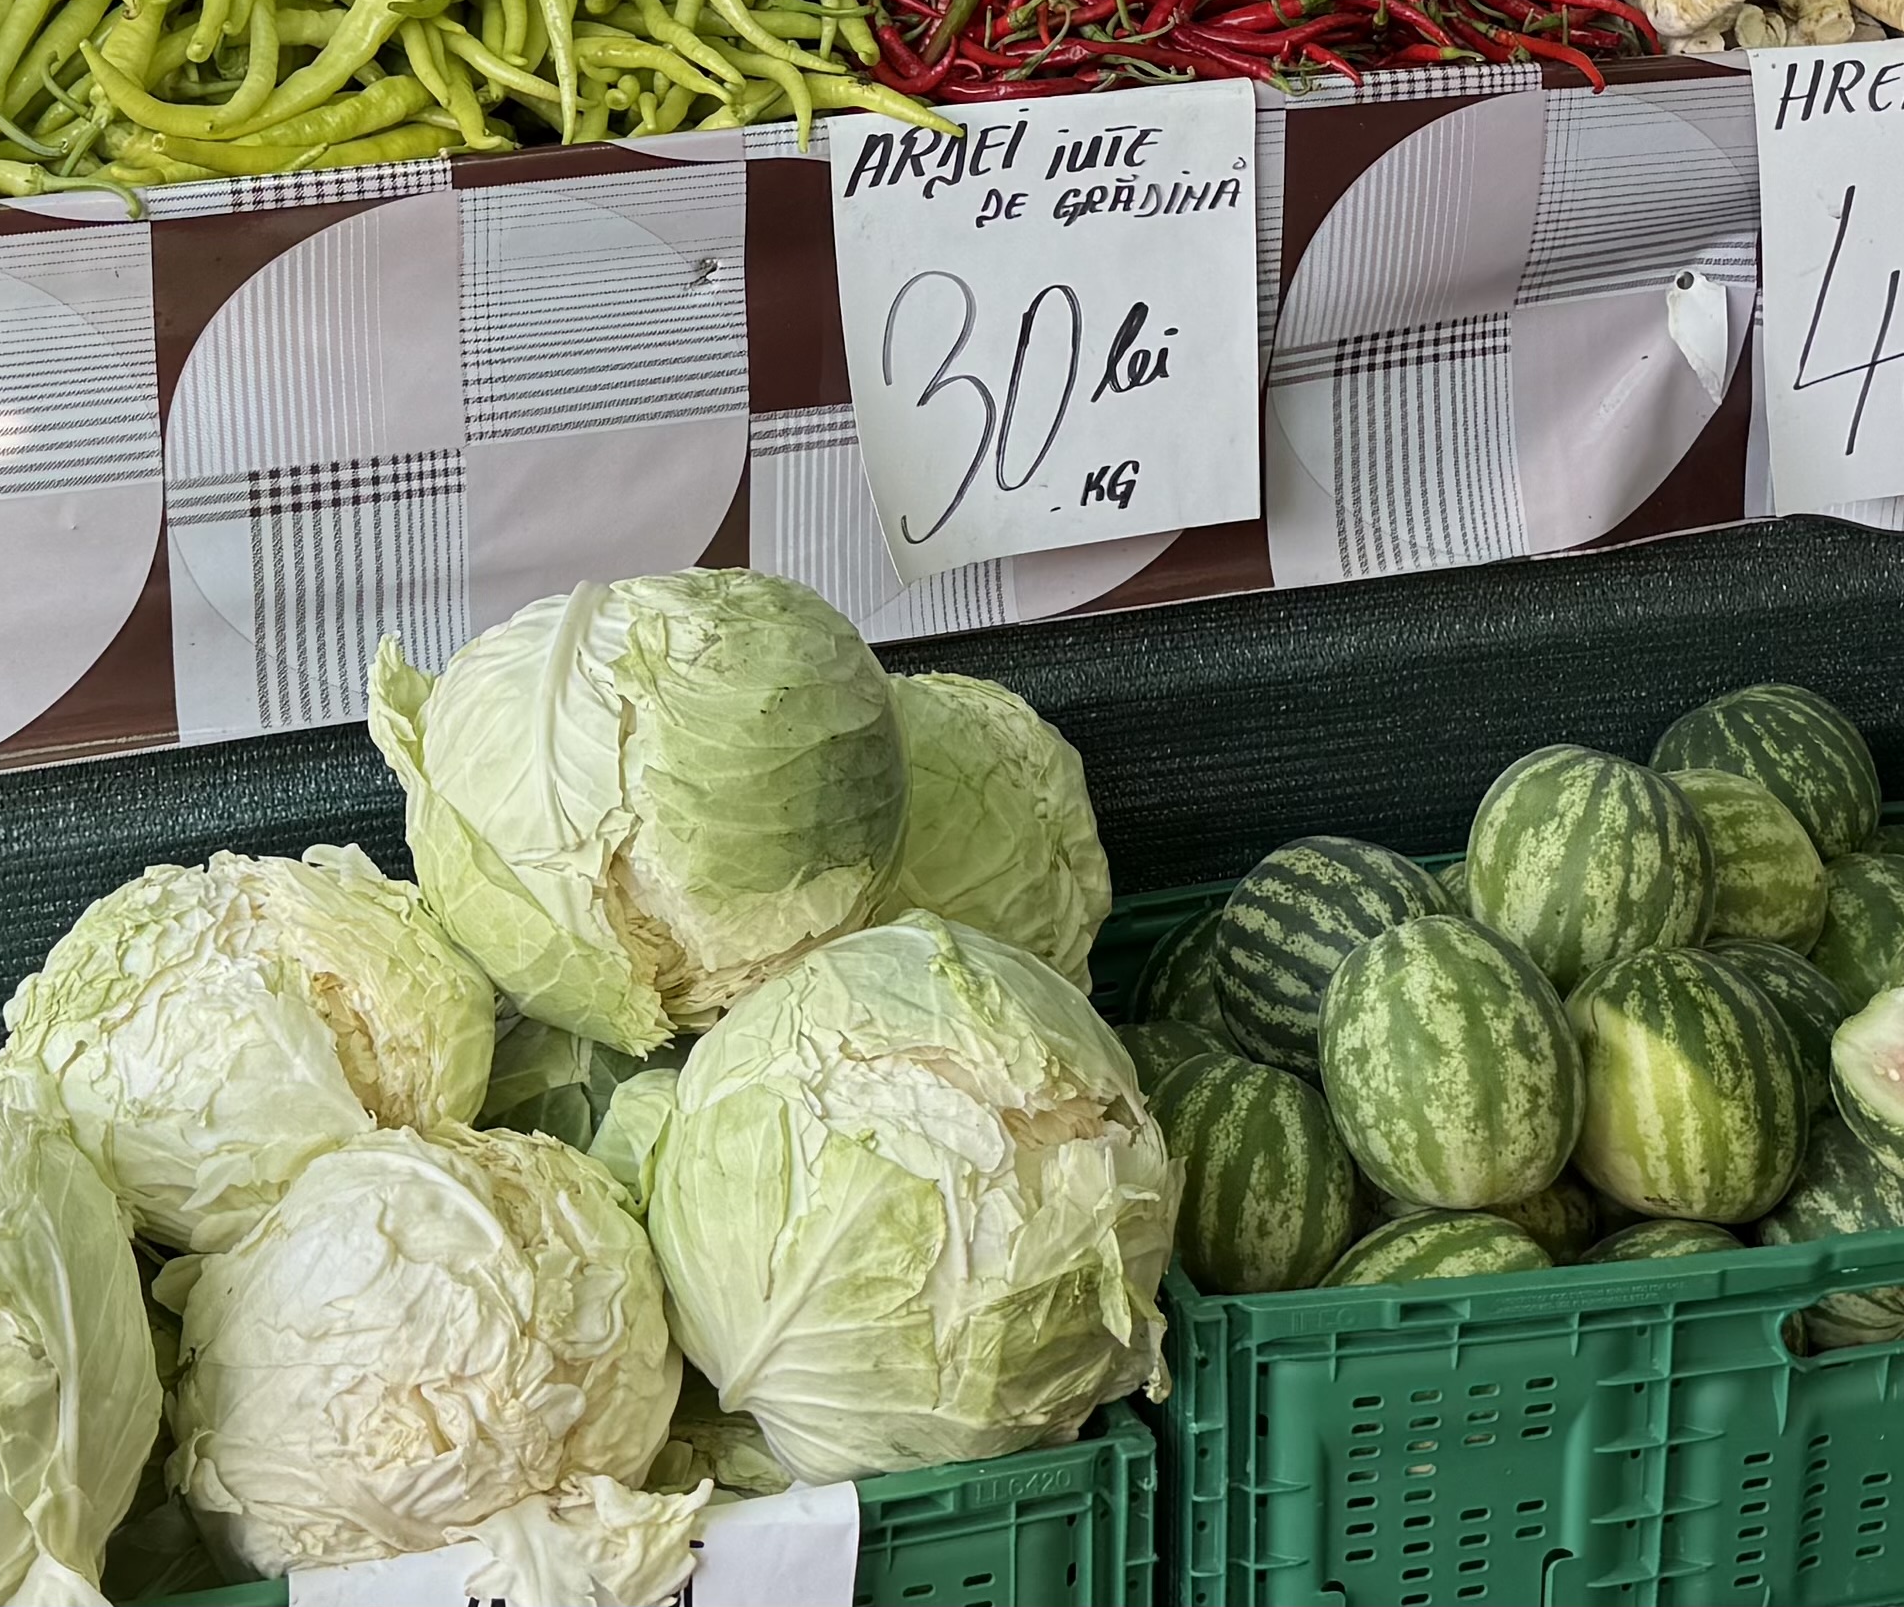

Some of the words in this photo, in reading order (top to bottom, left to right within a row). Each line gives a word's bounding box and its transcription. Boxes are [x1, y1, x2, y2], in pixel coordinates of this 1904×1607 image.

[976, 188, 1030, 228] DE
[882, 270, 1083, 544] 30
[1090, 301, 1180, 403] lei
[1080, 460, 1140, 509] KG
